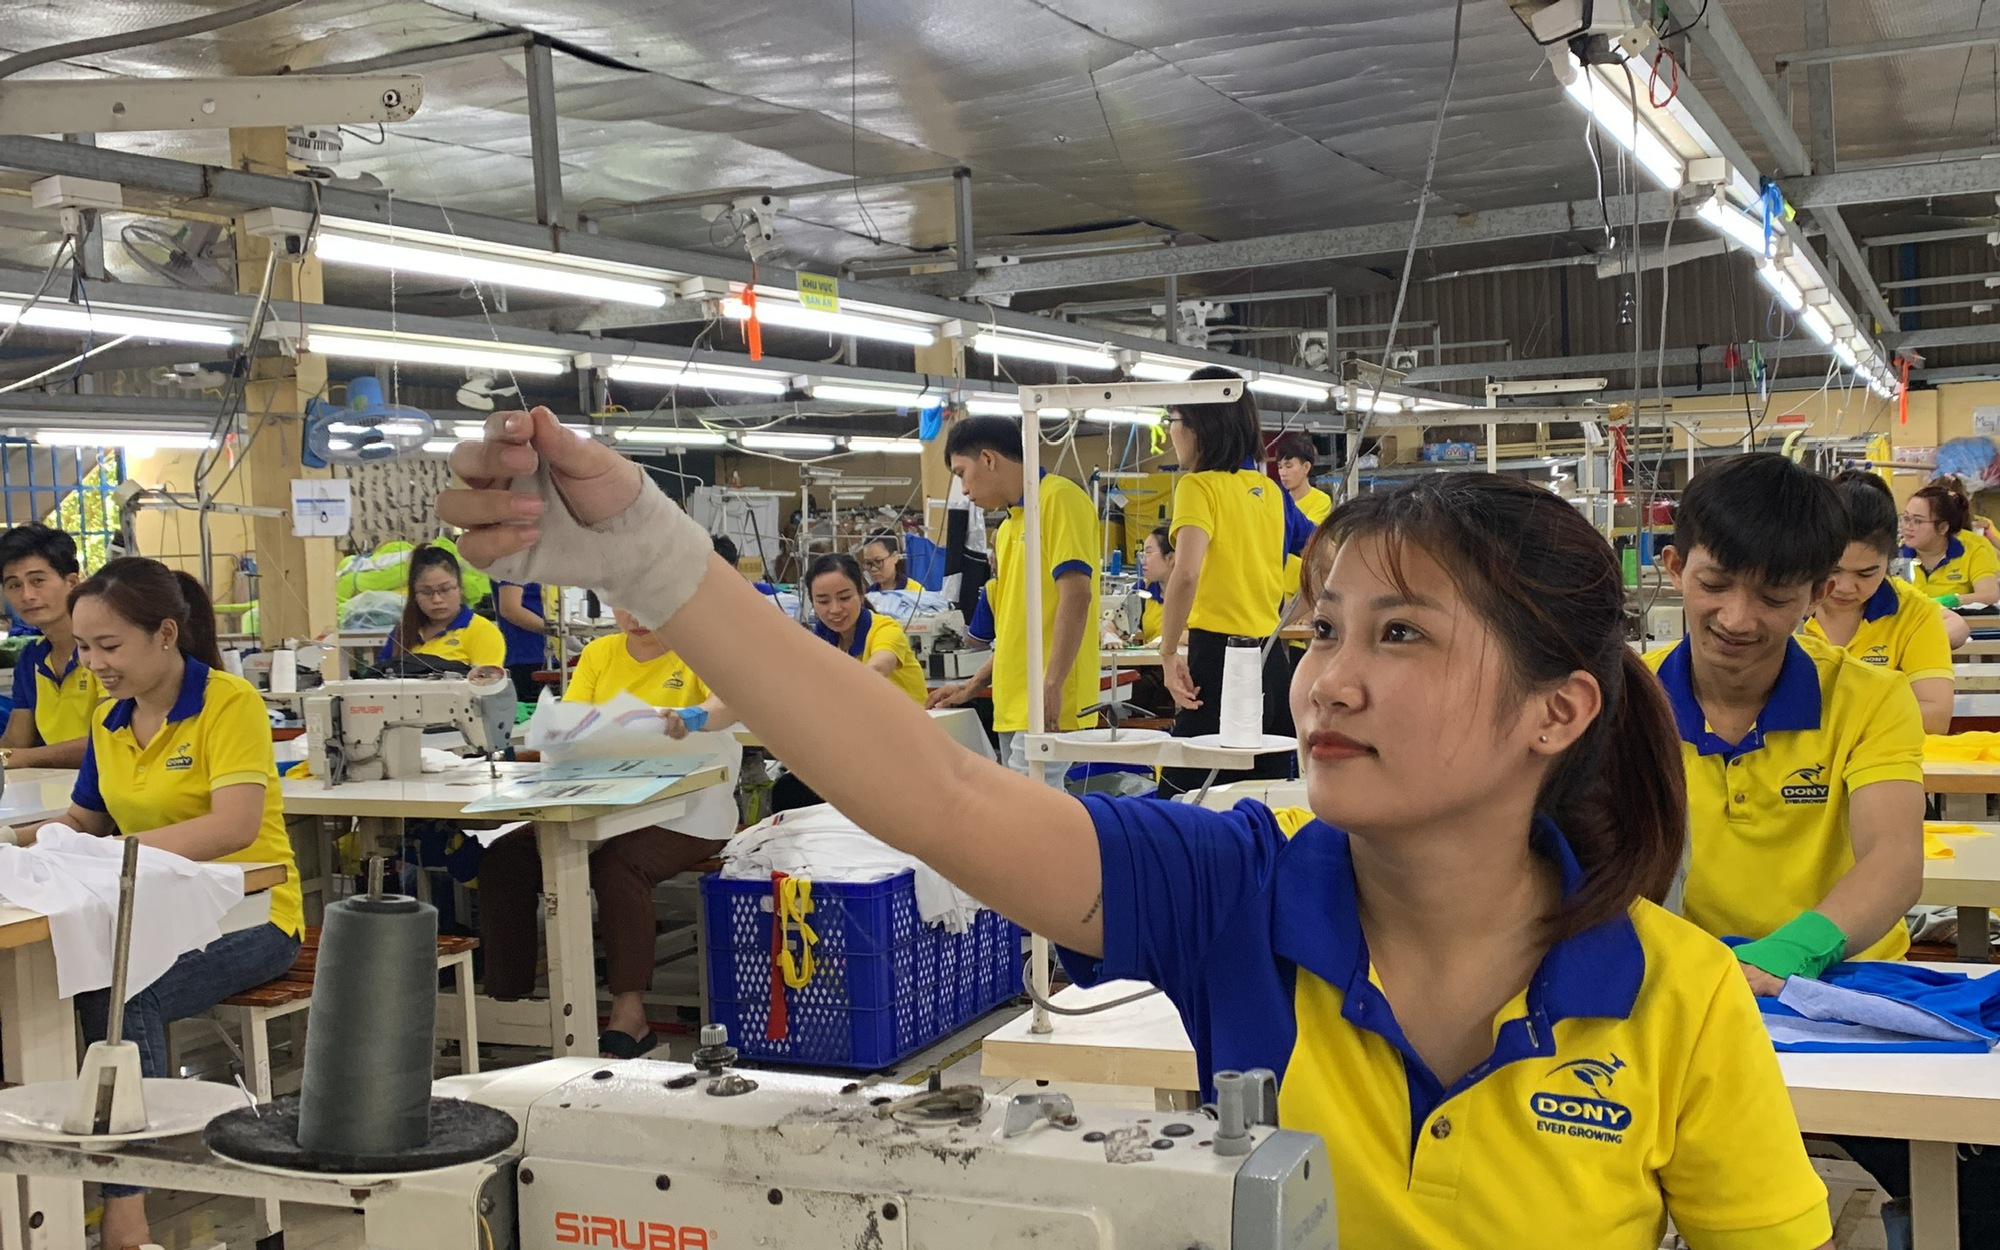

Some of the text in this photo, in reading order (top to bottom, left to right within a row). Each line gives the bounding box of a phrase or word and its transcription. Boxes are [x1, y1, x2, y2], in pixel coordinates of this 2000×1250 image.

[802, 278, 817, 290] KHU
[1783, 787, 1828, 796] DONY
[1537, 1097, 1627, 1125] DONY
[1537, 1120, 1623, 1144] EVER GROWING
